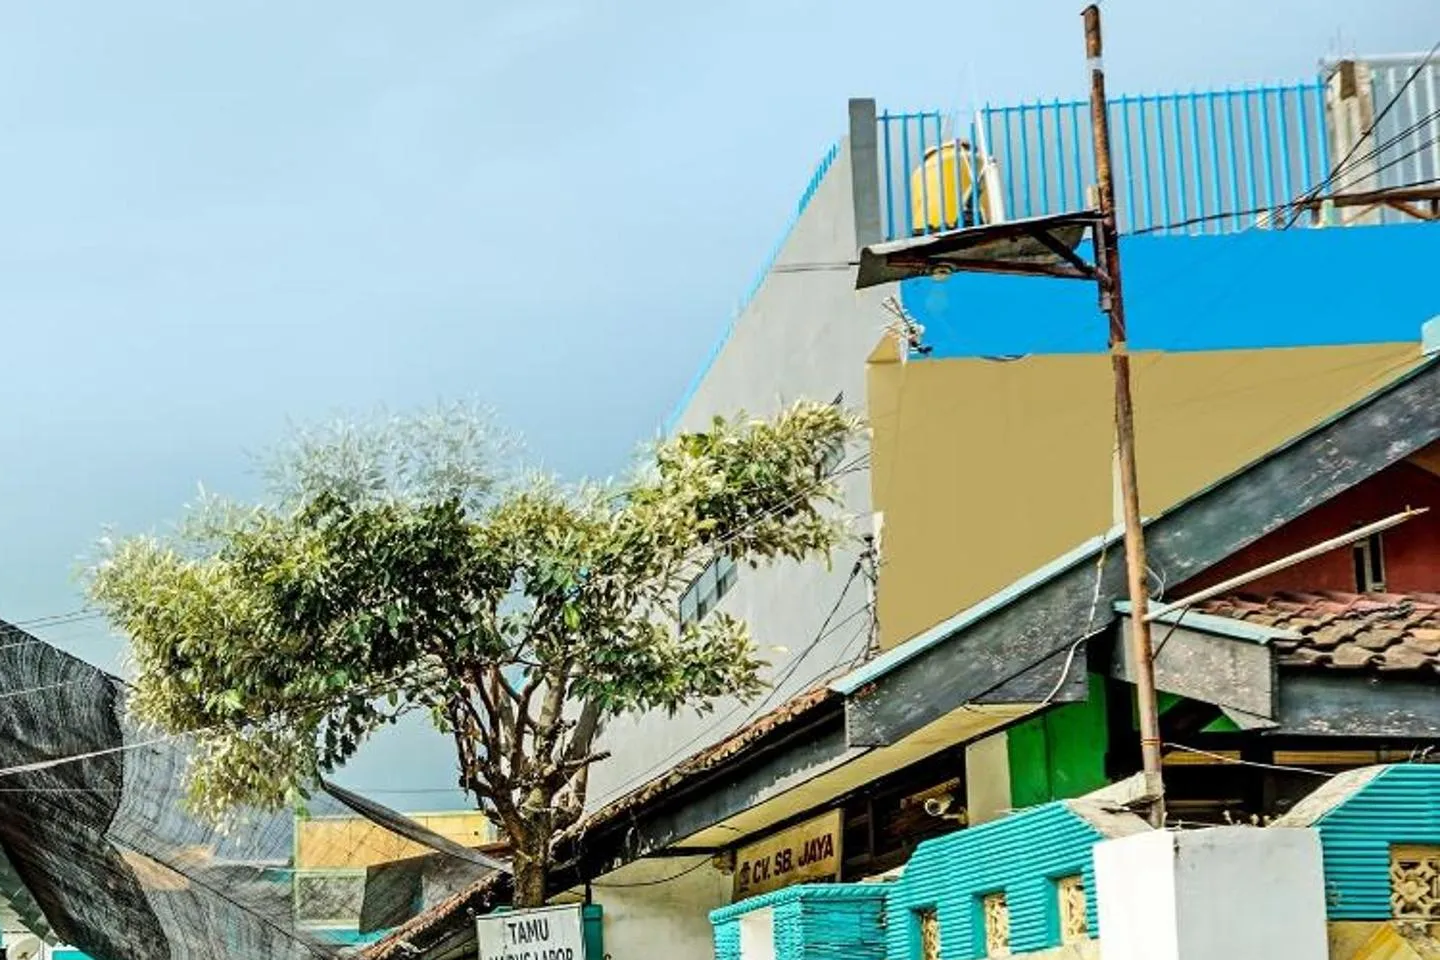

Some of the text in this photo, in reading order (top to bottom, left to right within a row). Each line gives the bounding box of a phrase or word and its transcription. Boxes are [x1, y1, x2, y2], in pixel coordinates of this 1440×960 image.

[752, 856, 771, 884] CV.
[798, 833, 834, 867] JAYA
[508, 918, 550, 945] TAMU
